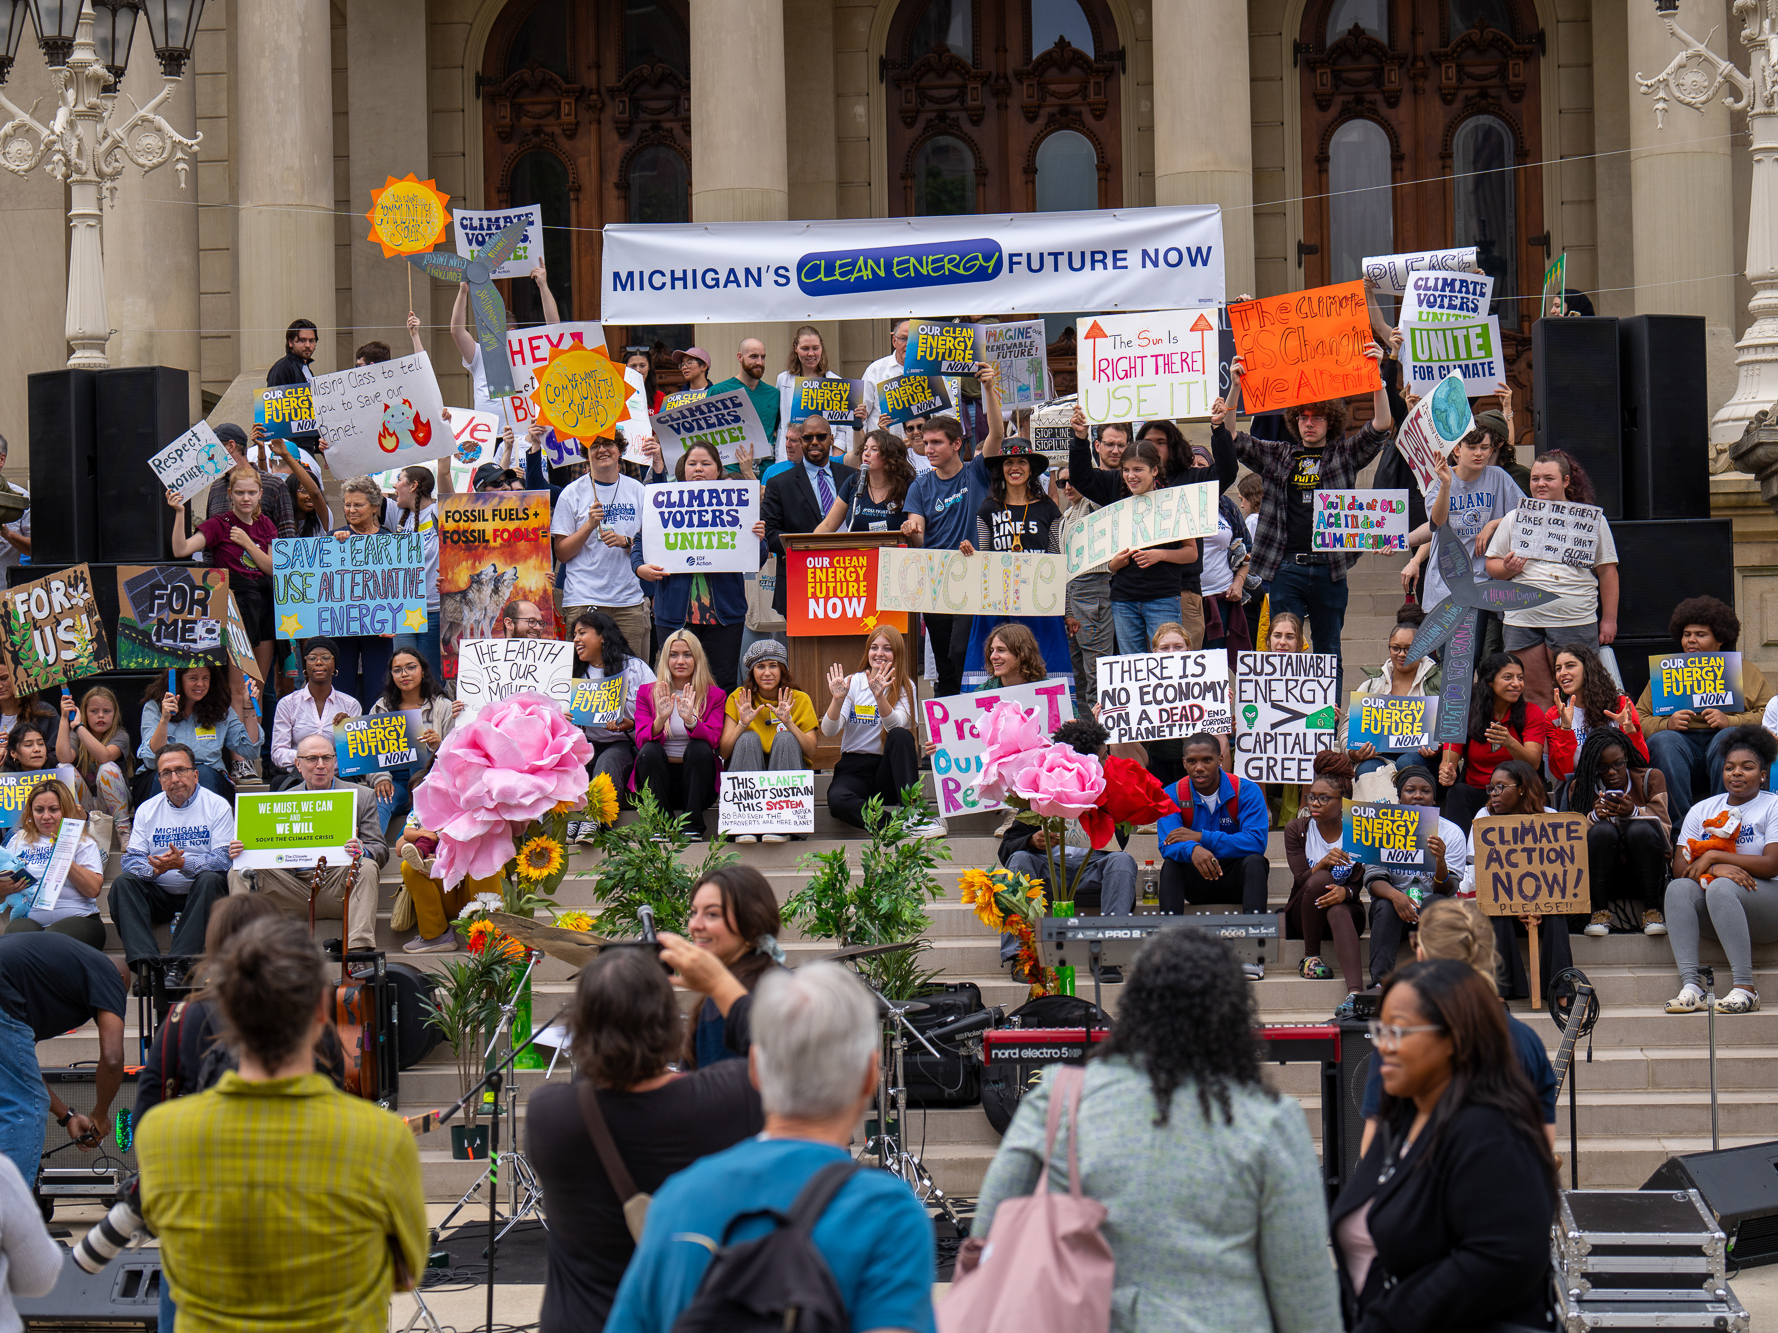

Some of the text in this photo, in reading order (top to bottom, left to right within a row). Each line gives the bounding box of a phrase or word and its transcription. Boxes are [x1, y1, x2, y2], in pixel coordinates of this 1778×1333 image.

[613, 246, 1213, 292] MICHIGAN'S CLEAN ENERGY FUTURE NOW
[1413, 277, 1487, 298] CLIMATE
[1417, 293, 1480, 316] VOTERS,
[1230, 301, 1292, 331] The
[918, 325, 974, 338] OUR CLEAN
[985, 326, 1032, 343] IMAGINE
[1109, 330, 1178, 349] The Sun Is
[918, 335, 974, 349] ENERGY
[986, 340, 1035, 353] RENEWABLE
[1415, 326, 1485, 361] UNITE
[917, 349, 973, 363] FUTURE
[997, 347, 1038, 359] FUTURE!
[946, 361, 975, 372] NOW
[1099, 351, 1201, 383] RIGHT THERE
[1413, 364, 1435, 381] FOR
[802, 380, 850, 391] OUR CLEAN
[801, 389, 849, 400] ENERGY
[1085, 380, 1208, 423] USE IT!
[656, 395, 743, 424] CLIMATE
[801, 399, 848, 411] FUTURE
[668, 410, 745, 435] VOTERS,
[827, 410, 850, 421] NOW
[1035, 427, 1070, 438] STOP LINE
[1036, 440, 1070, 450] STOP LINE
[652, 488, 749, 509] CLIMATE
[1348, 495, 1405, 514] die of OLD
[445, 508, 530, 523] FOSSIL FUELS
[991, 510, 1012, 524] NO
[1520, 498, 1600, 520] KEEP THE GREAT
[659, 509, 742, 529] VOTERS,
[1316, 511, 1386, 529] AGE die of
[1516, 514, 1593, 532] LAKES COOL AND
[442, 527, 538, 544] FOSSIL FOOLS
[993, 521, 1038, 537] LINE 5
[1067, 484, 1217, 574] GET REAL
[1521, 527, 1593, 547] DO YOUR PART
[664, 531, 737, 550] UNITE!
[1314, 531, 1364, 549] CLIMATE
[274, 533, 422, 569] SAVE EARTH
[1545, 545, 1558, 553] STOP
[1563, 548, 1594, 561] GLOBAL
[807, 556, 867, 568] OUR CLEAN
[807, 566, 866, 582] ENERGY
[274, 567, 425, 605] USE ALTERNATIVE
[808, 582, 867, 597] FUTURE
[15, 580, 69, 623] FOR
[149, 583, 212, 617] FOR
[808, 597, 866, 619] NOW
[318, 603, 403, 636] ENERGY
[465, 640, 564, 665] THE EARTH
[1102, 654, 1206, 685] THERE IS
[1239, 654, 1336, 679] SUSTAINABLE
[1660, 657, 1724, 669] OUR CLEAN
[483, 663, 539, 684] IS OUR
[1662, 667, 1724, 682] ENERGY
[1101, 680, 1229, 709] NO ECONOMY
[1239, 679, 1335, 705] ENERGY
[1663, 680, 1725, 697] FUTURE
[1361, 697, 1425, 710] OUR CLEAN
[1699, 692, 1728, 706] NOW
[344, 715, 406, 731] OUR CLEAN
[1105, 704, 1204, 730] ON A DEAD
[1363, 708, 1423, 724] ENERGY
[346, 725, 406, 744] ENERGY
[1118, 723, 1197, 743] PLANET!!!
[1361, 720, 1422, 735] FUTURE
[348, 738, 408, 758] FUTURE
[1236, 731, 1334, 755] CAPITALIST
[1394, 734, 1425, 746] NOW
[385, 749, 411, 765] NOW
[727, 774, 806, 790] THIS PLANET
[724, 786, 813, 802] CANNOT SUSTAIN
[258, 800, 333, 814] WE MUST, WE CAN
[733, 800, 804, 812] THIS SYSTEM
[276, 822, 314, 834] WE WILL
[1481, 819, 1583, 846] CLIMATE
[154, 838, 209, 848] FUTURE NOW
[1485, 845, 1575, 871] ACTION
[1492, 867, 1584, 903] NOW!
[1500, 901, 1573, 915] PLEASE!!
[1105, 930, 1141, 939] PRO 2
[964, 1028, 987, 1039] Roland
[992, 1047, 1082, 1059] nord electro 5 HP
